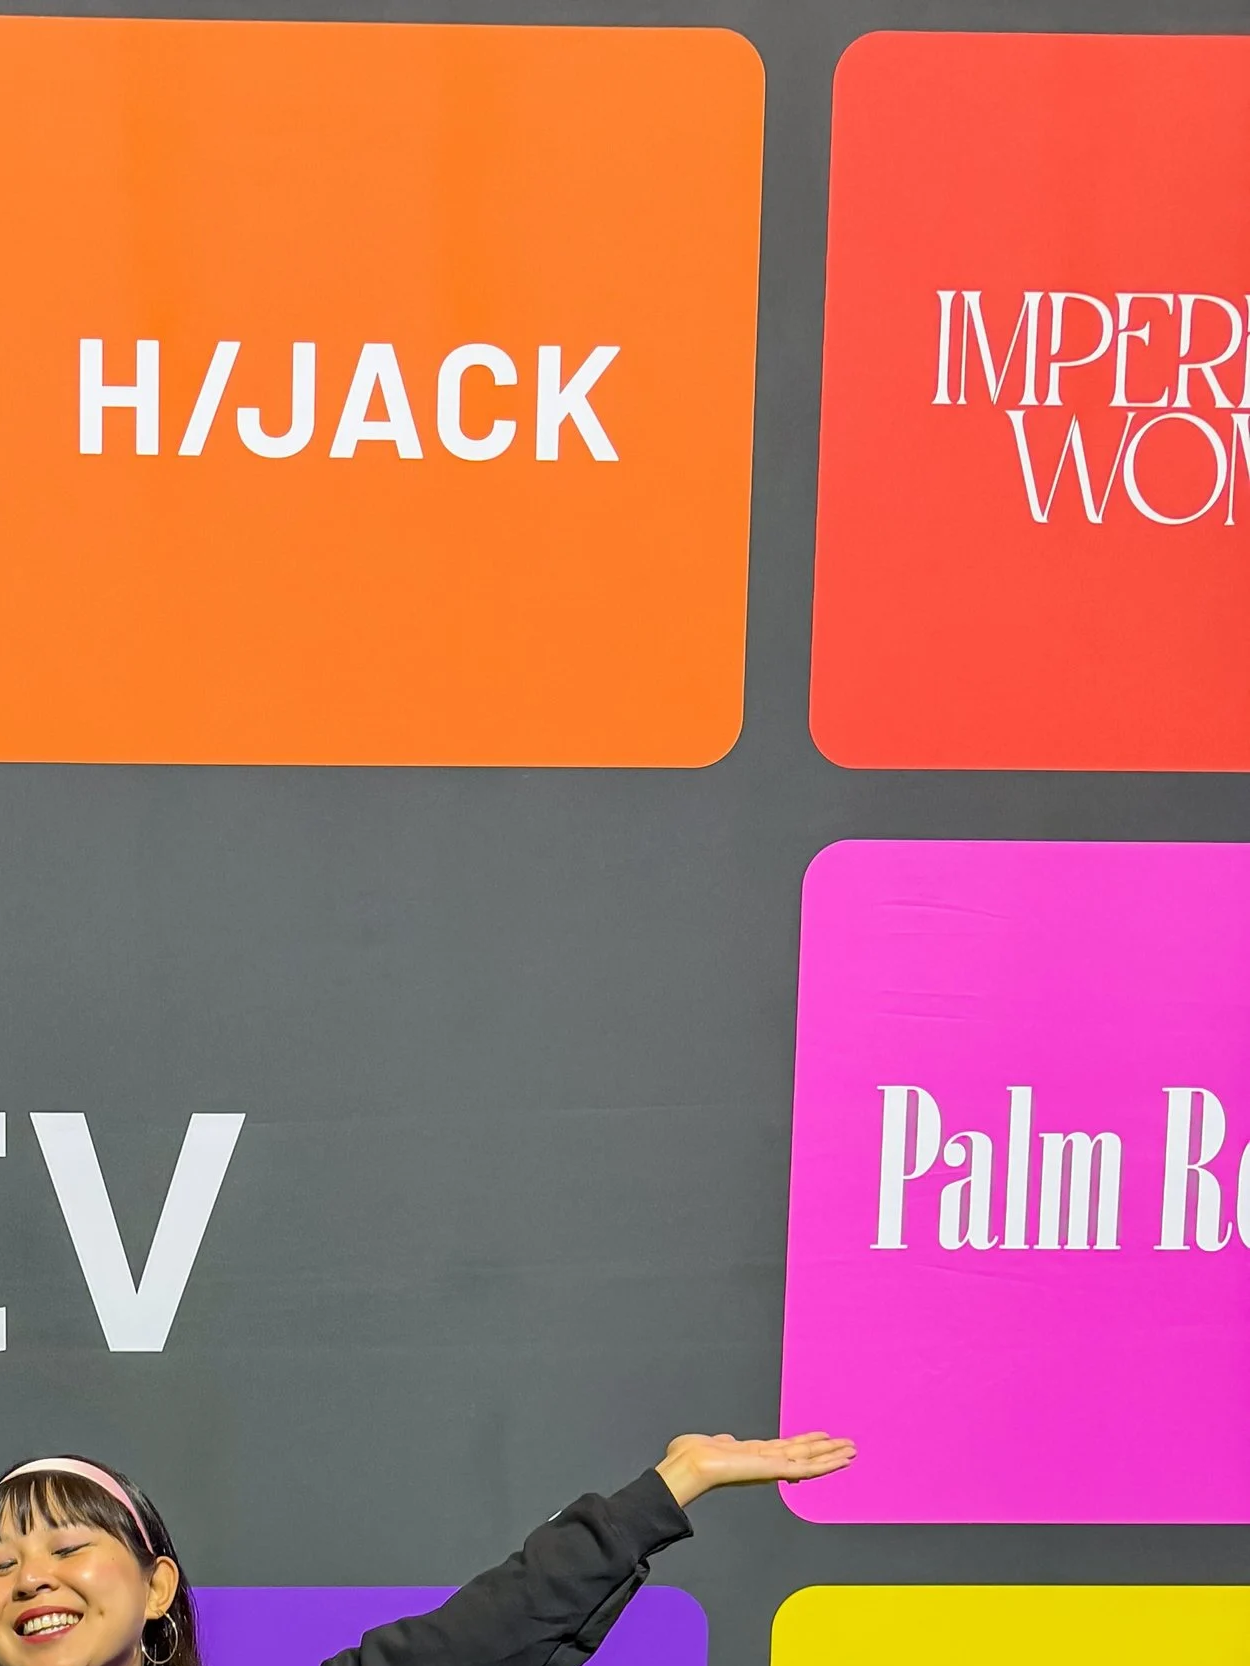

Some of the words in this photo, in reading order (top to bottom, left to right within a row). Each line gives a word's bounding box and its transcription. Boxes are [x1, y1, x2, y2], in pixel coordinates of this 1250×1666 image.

[79, 338, 621, 462] H/JACK
[869, 1085, 1123, 1251] Palm
[1153, 1087, 1250, 1252] R
